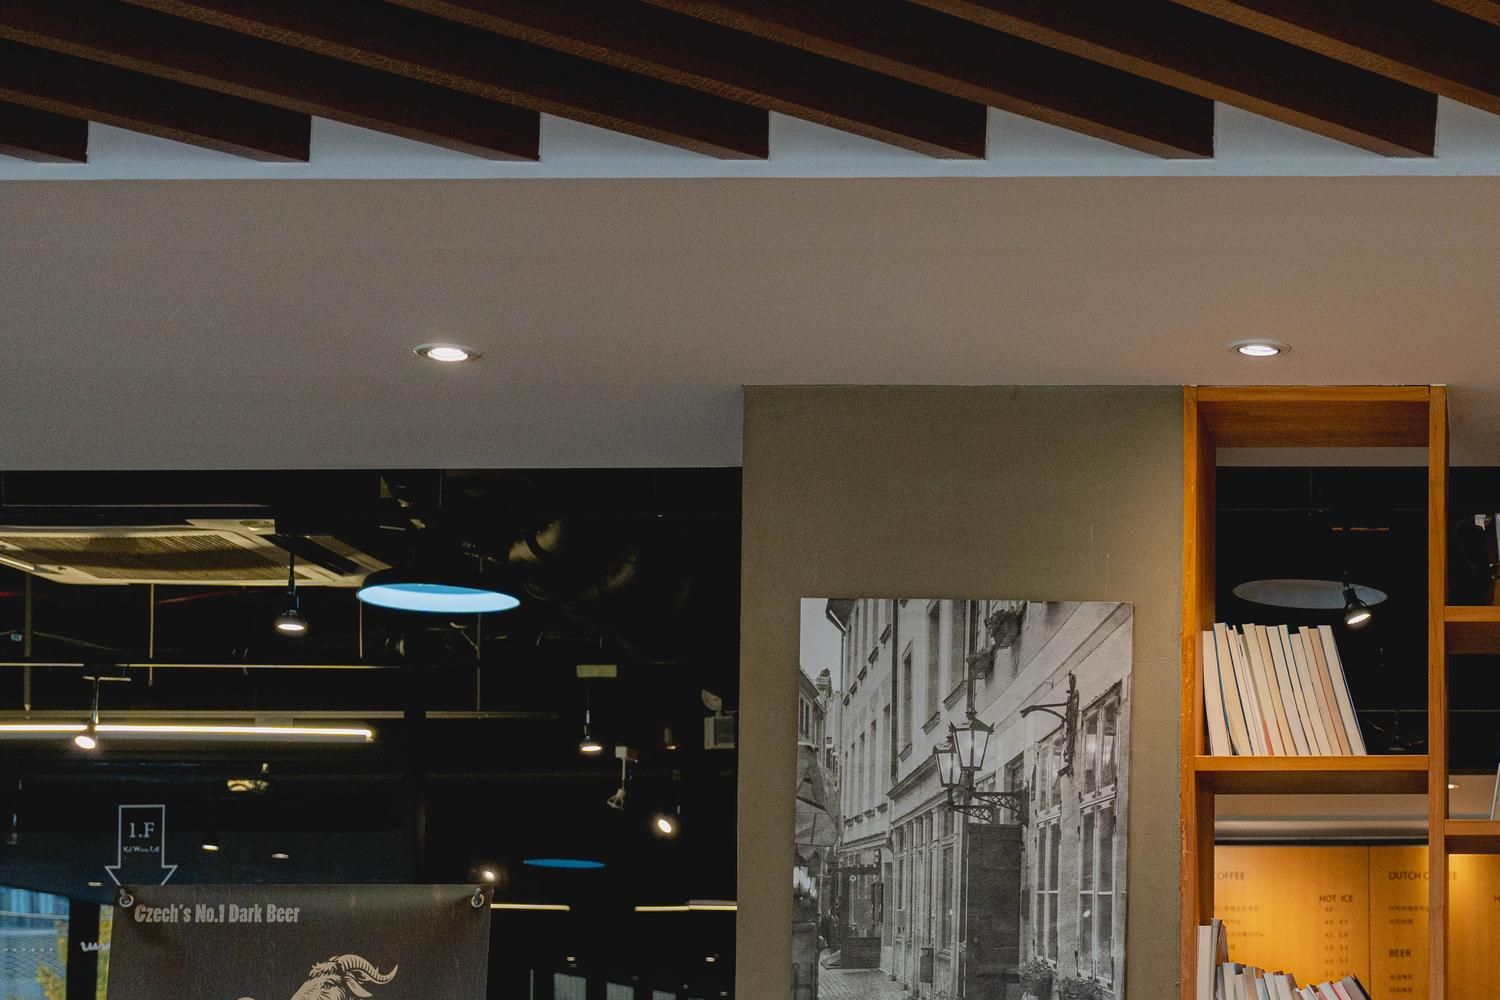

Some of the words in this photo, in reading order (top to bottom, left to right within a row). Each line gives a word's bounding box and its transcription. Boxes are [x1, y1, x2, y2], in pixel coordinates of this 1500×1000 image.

[128, 822, 155, 838] 1.F
[1388, 871, 1421, 880] DUTCH
[1319, 895, 1336, 903] HOT
[1340, 895, 1354, 903] ICE
[134, 904, 191, 923] Czech's
[195, 905, 225, 923] No.1
[228, 904, 262, 923] Dark
[266, 904, 300, 923] Beer
